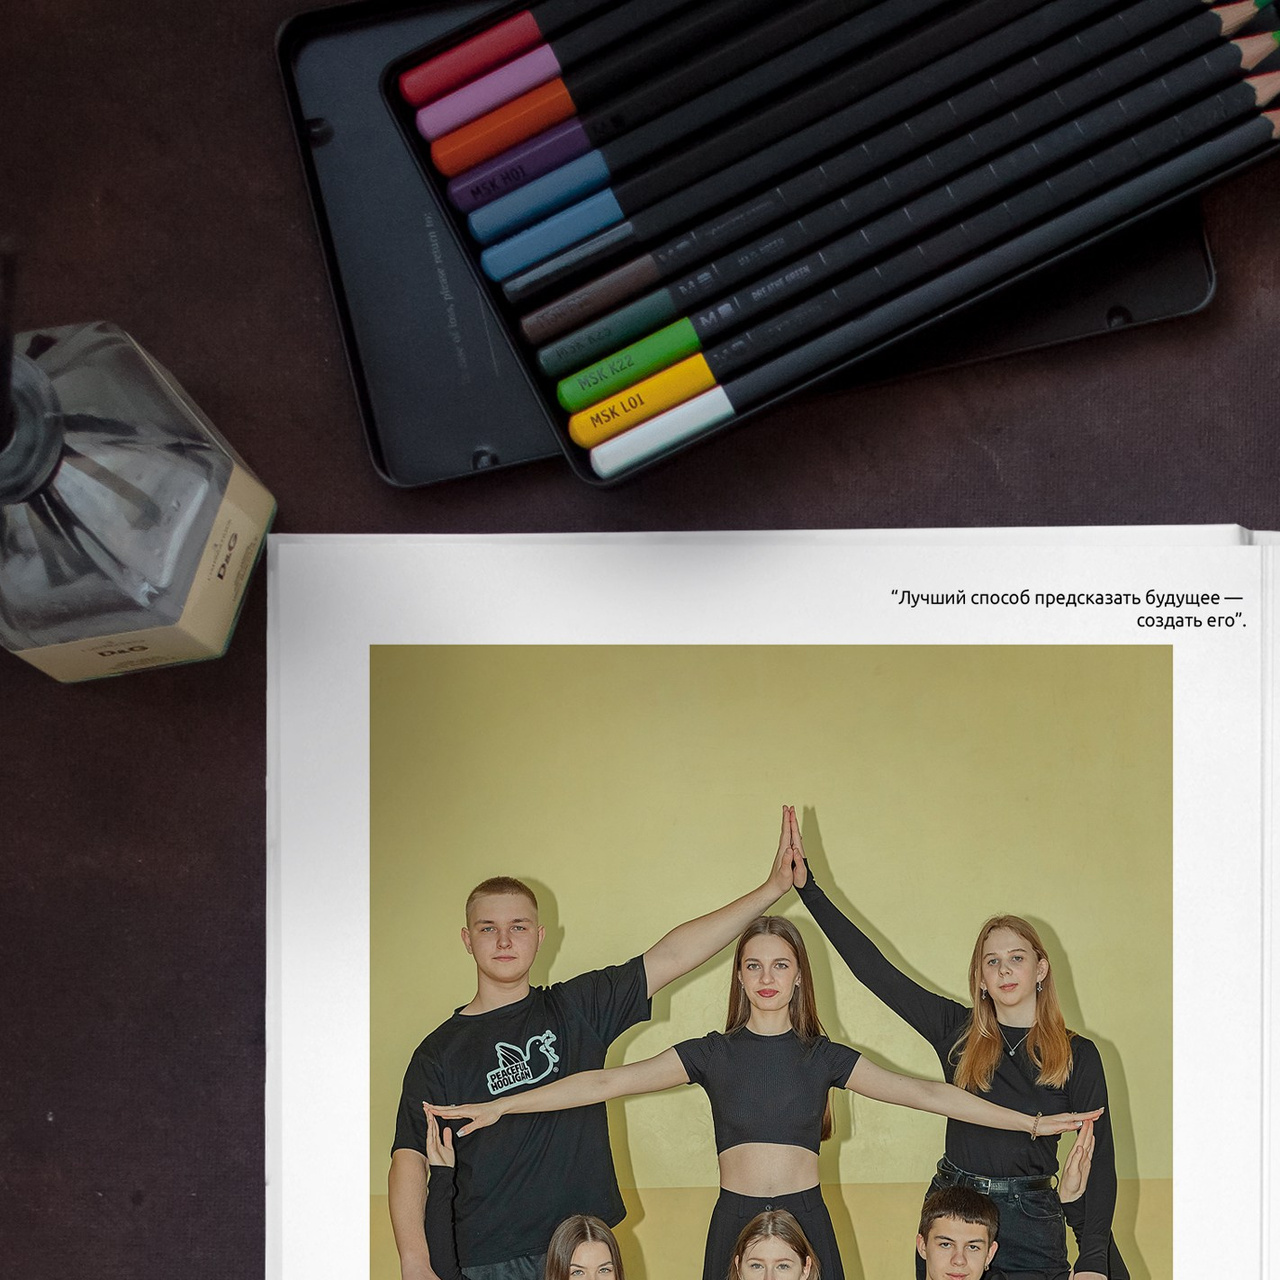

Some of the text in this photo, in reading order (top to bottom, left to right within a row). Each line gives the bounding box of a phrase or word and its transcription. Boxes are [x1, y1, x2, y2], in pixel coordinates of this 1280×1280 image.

[578, 354, 634, 390] MSK K22
[590, 393, 644, 428] MSK L01
[971, 589, 1030, 605] способ
[1035, 592, 1141, 607] предсказать
[1145, 589, 1221, 607] будущее
[1137, 615, 1203, 629] создать
[490, 1062, 528, 1082] PEACEFUL
[491, 1070, 531, 1091] HOOLIGAN
